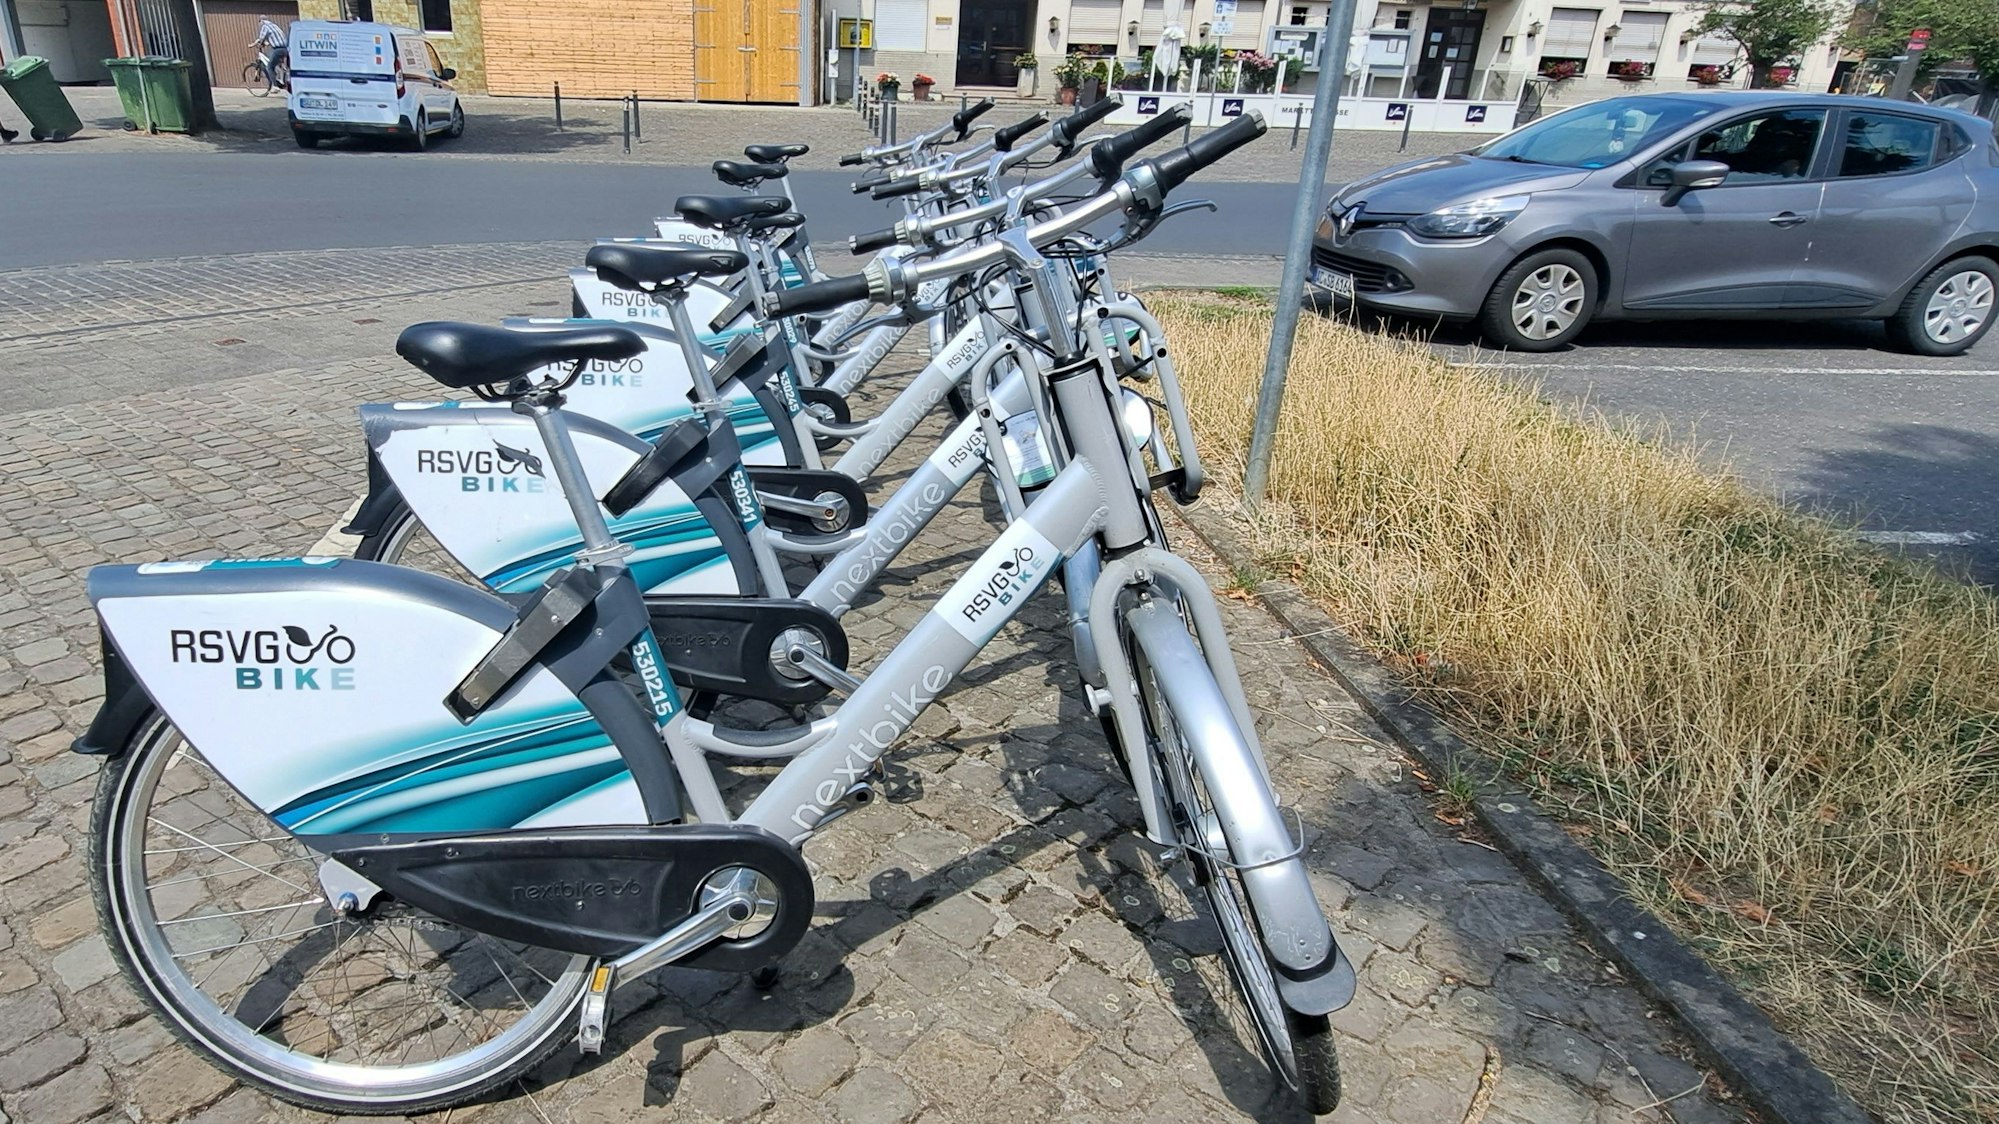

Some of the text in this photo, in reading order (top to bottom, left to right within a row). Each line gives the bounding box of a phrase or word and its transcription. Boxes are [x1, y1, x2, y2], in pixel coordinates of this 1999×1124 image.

[299, 40, 338, 50] LITWIN
[602, 292, 646, 307] RSVG
[627, 308, 662, 318] BIK
[782, 315, 798, 343] 30029
[840, 326, 907, 394] nextbike
[946, 343, 972, 369] RSVG
[965, 342, 984, 362] BIK
[581, 373, 643, 388] BIKE
[778, 370, 800, 413] 530245
[857, 388, 943, 476] nextbike
[417, 449, 493, 475] RSVG
[947, 433, 982, 469] RSVG
[461, 476, 544, 494] BIKE
[729, 470, 758, 523] 530341
[830, 481, 946, 602] nextbike
[962, 572, 1010, 623] RSVG
[997, 556, 1046, 607] BIKE
[170, 629, 280, 665] RSVG
[235, 666, 357, 691] BIKE
[632, 640, 674, 718] 530215
[790, 664, 953, 831] nextbike
[511, 879, 607, 901] nextbike
